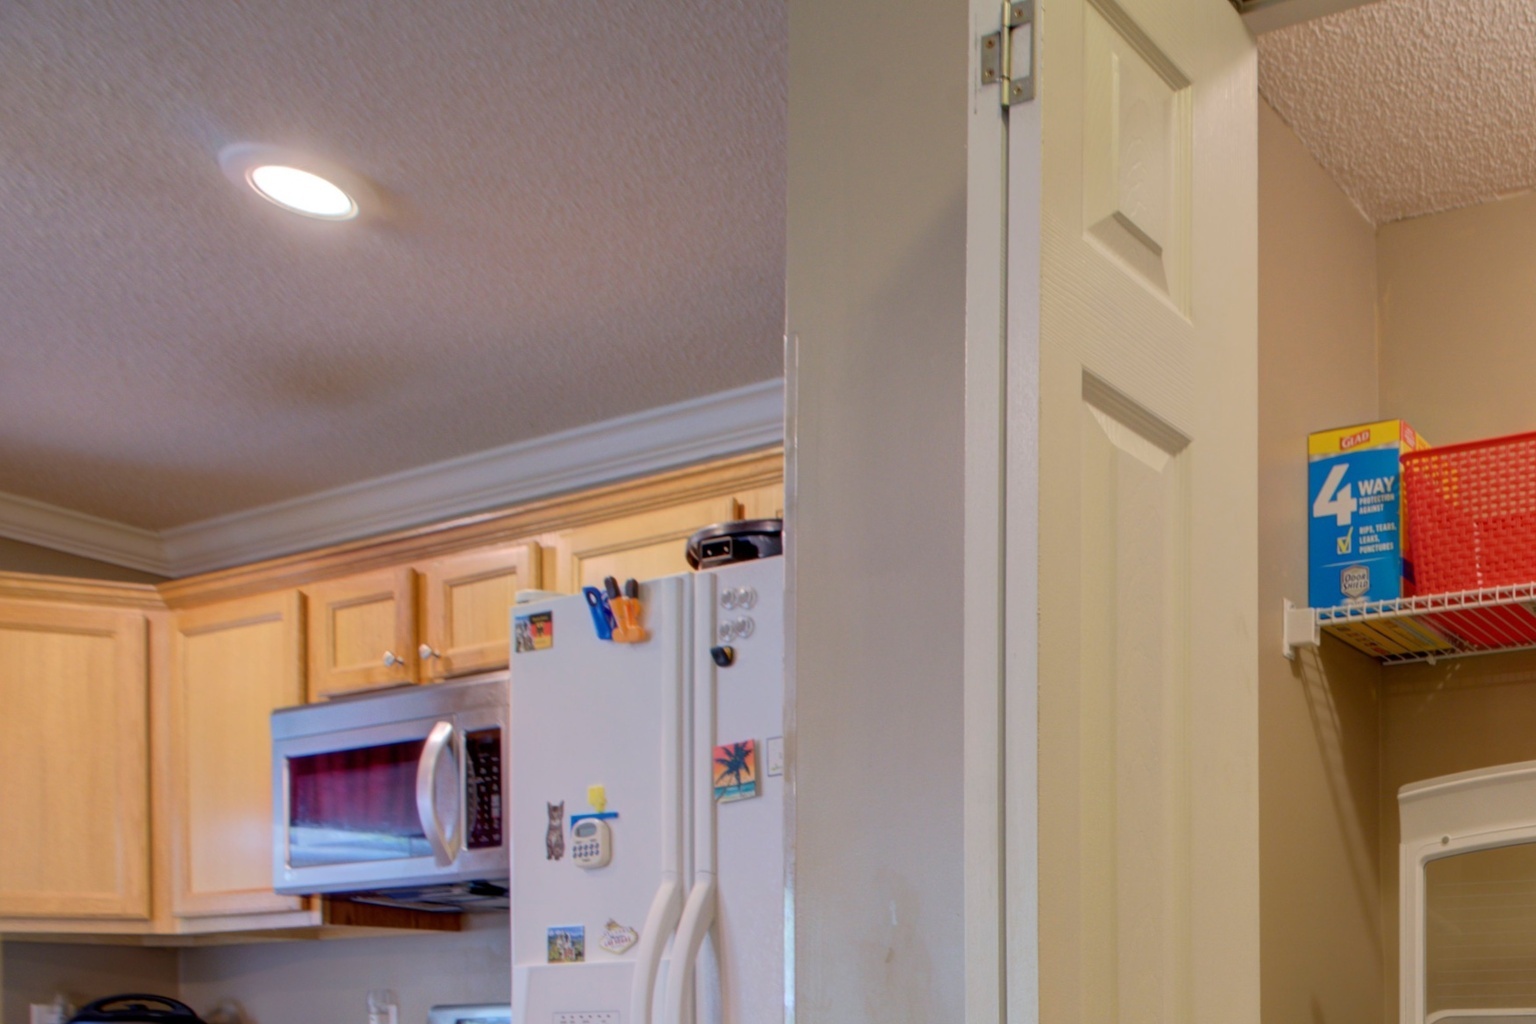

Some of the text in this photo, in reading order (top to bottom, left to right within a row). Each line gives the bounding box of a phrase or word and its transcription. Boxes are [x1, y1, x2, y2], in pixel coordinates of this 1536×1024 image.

[1341, 430, 1370, 449] GLAD
[1358, 476, 1395, 496] WAY
[1312, 463, 1358, 526] 4
[1359, 504, 1384, 514] AGAINST
[1344, 581, 1368, 590] SHIELD
[1345, 574, 1366, 583] ODOR
